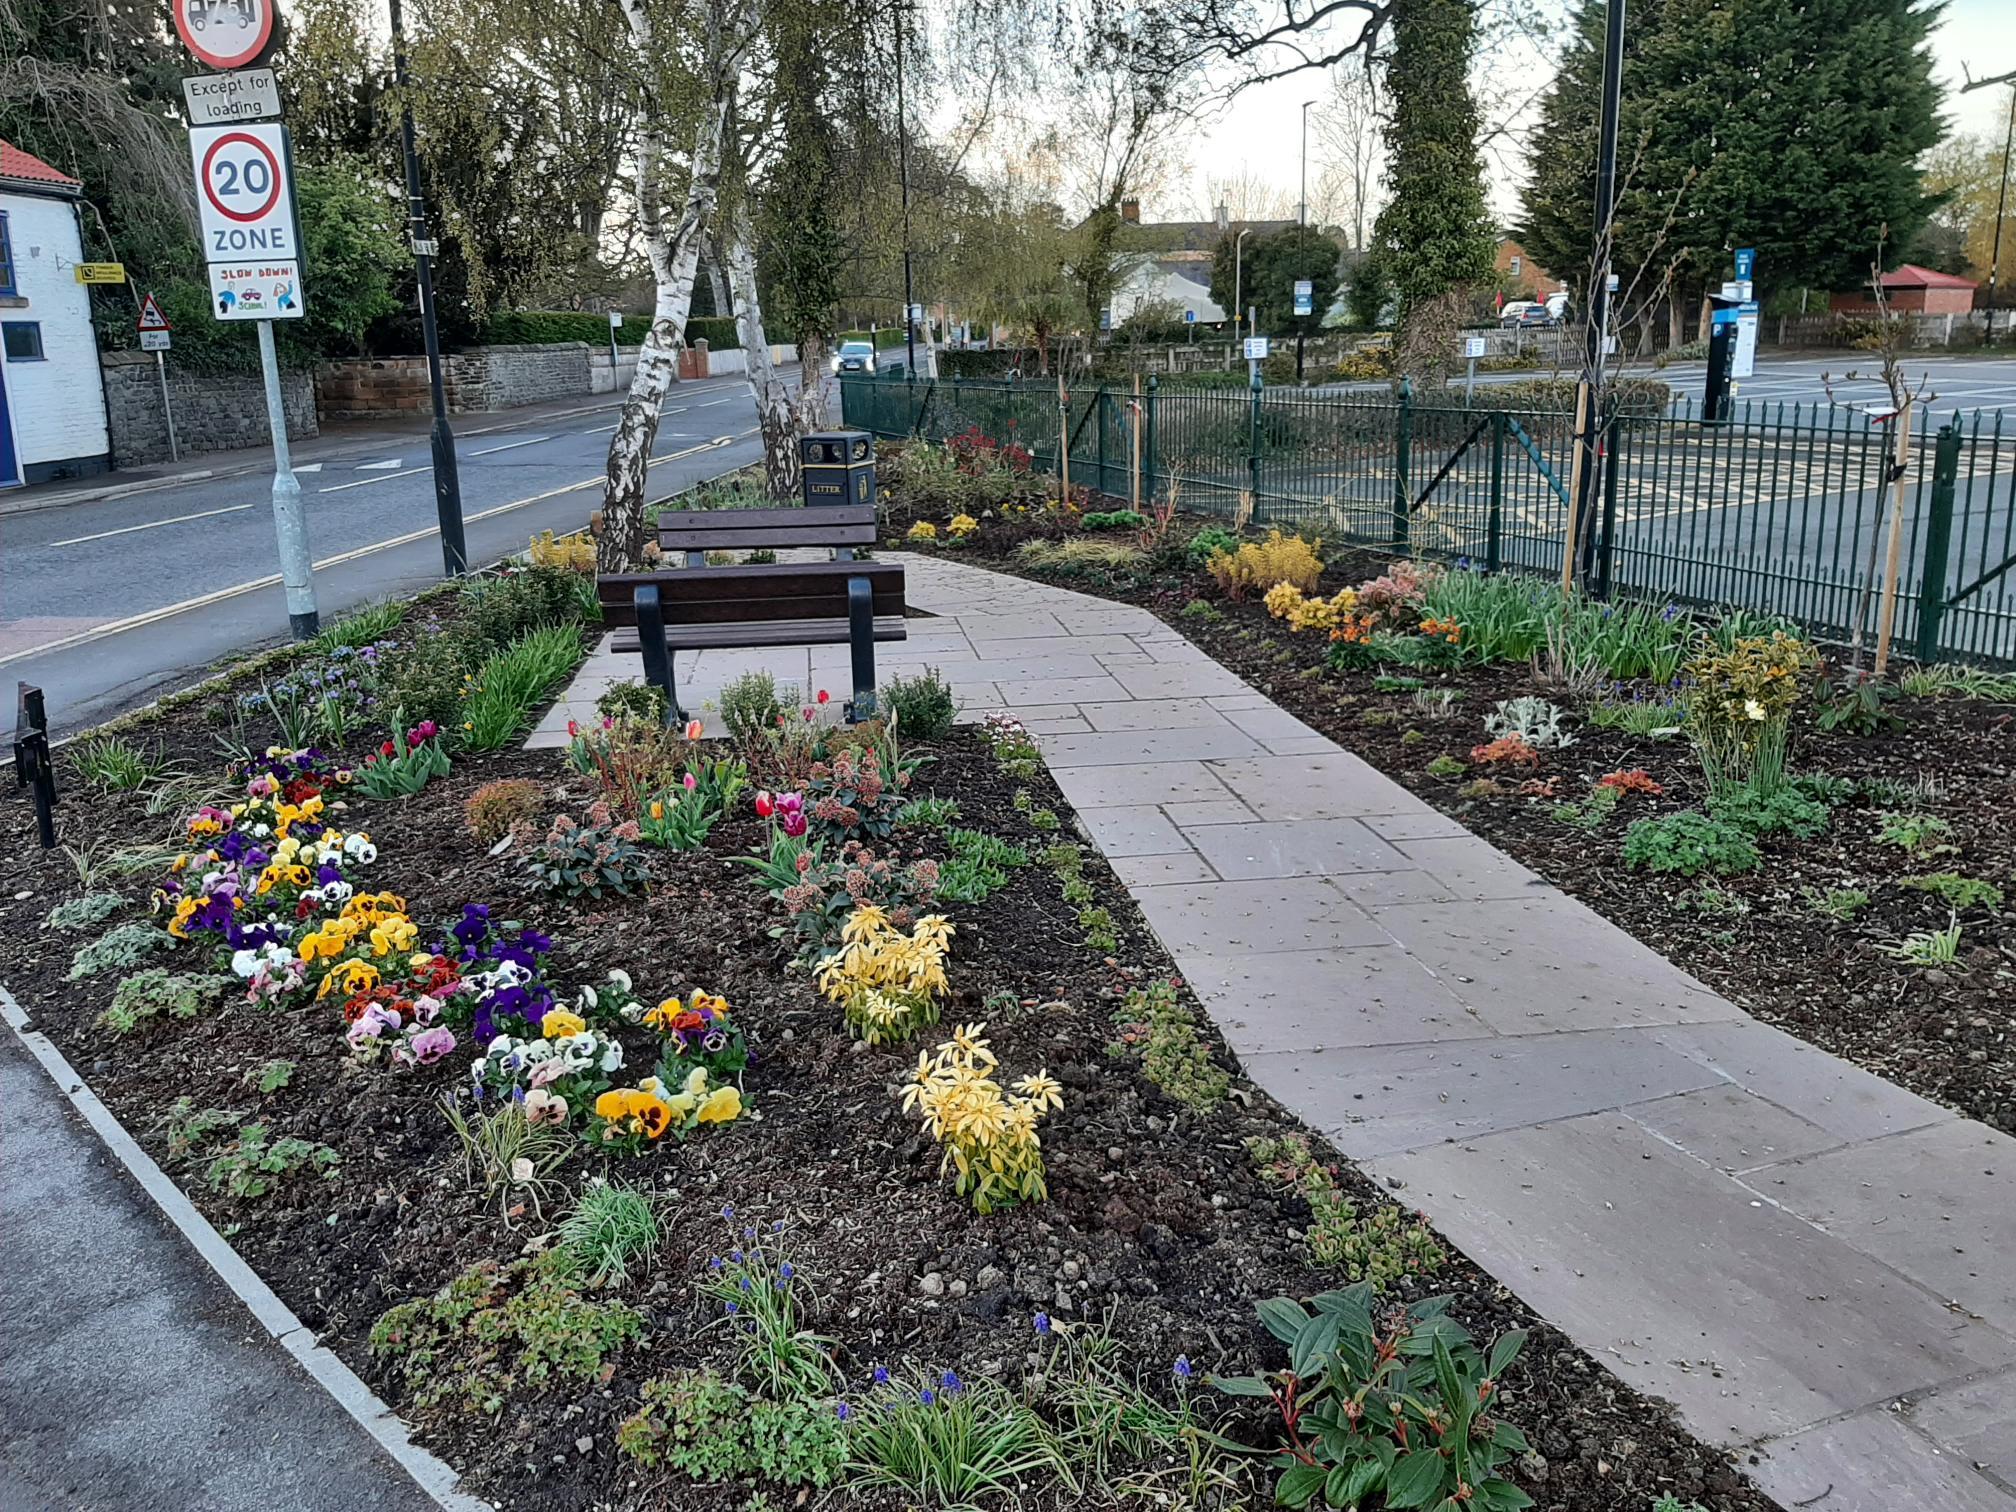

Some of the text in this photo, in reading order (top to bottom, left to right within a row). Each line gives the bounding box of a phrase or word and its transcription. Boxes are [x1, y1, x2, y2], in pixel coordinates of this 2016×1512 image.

[191, 76, 269, 96] Except for
[207, 101, 263, 116] loading
[215, 159, 269, 195] 20
[213, 228, 285, 251] ZONE
[221, 267, 293, 280] SLOW DOWN!
[811, 485, 840, 493] LITTER
